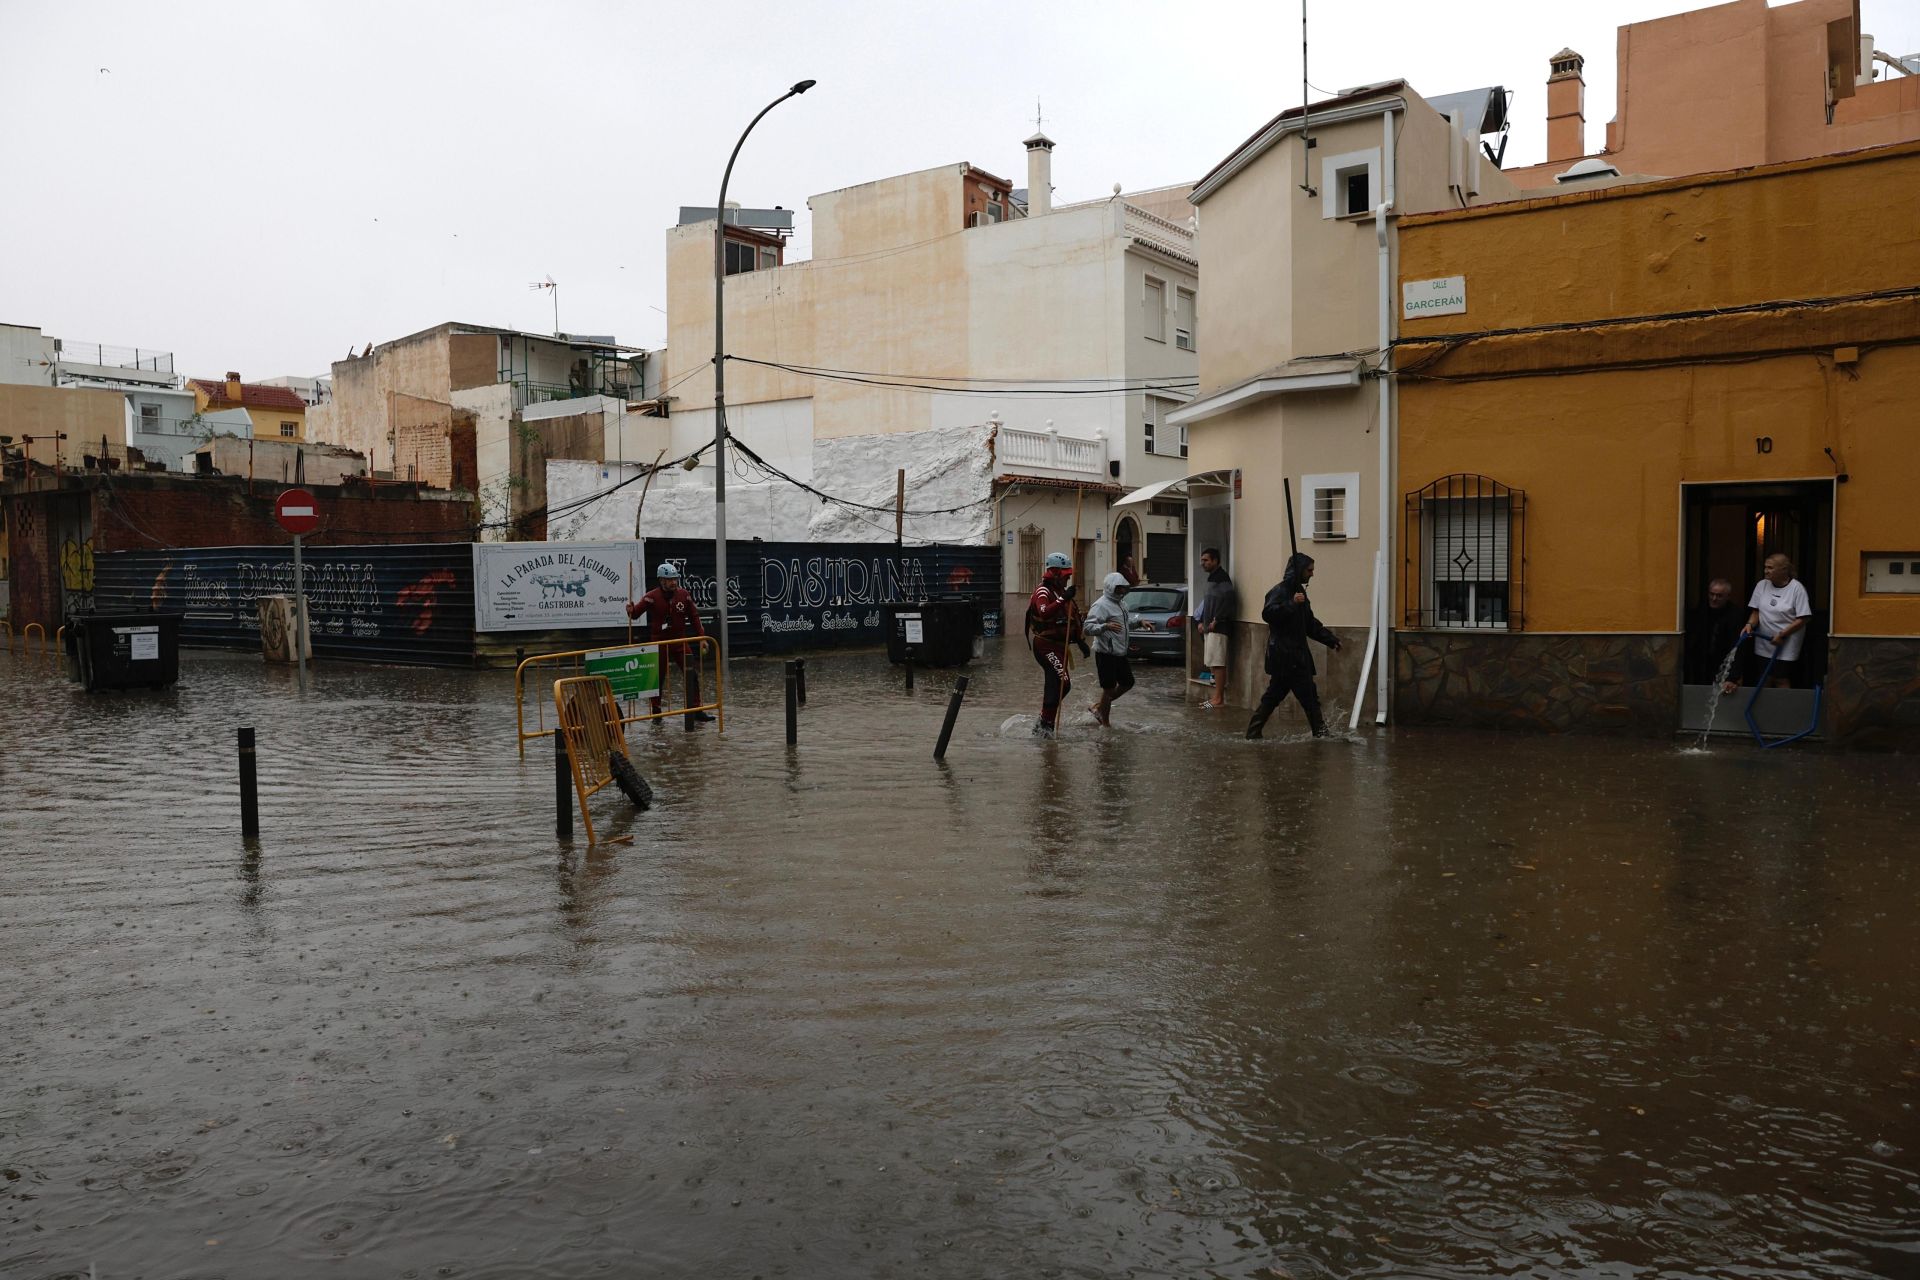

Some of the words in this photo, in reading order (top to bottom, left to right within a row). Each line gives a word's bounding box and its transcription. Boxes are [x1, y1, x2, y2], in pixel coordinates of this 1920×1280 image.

[1432, 280, 1447, 290] CALLE
[1405, 295, 1463, 310] GARCERÁN
[1756, 437, 1773, 454] 10
[501, 574, 517, 588] LA
[514, 554, 554, 578] PARADA
[558, 553, 575, 565] DEL
[578, 555, 621, 585] AGUADOR
[760, 557, 929, 608] PASTRANA
[538, 600, 585, 610] GASTROBAR
[760, 612, 815, 633] Productos
[864, 610, 880, 627] del
